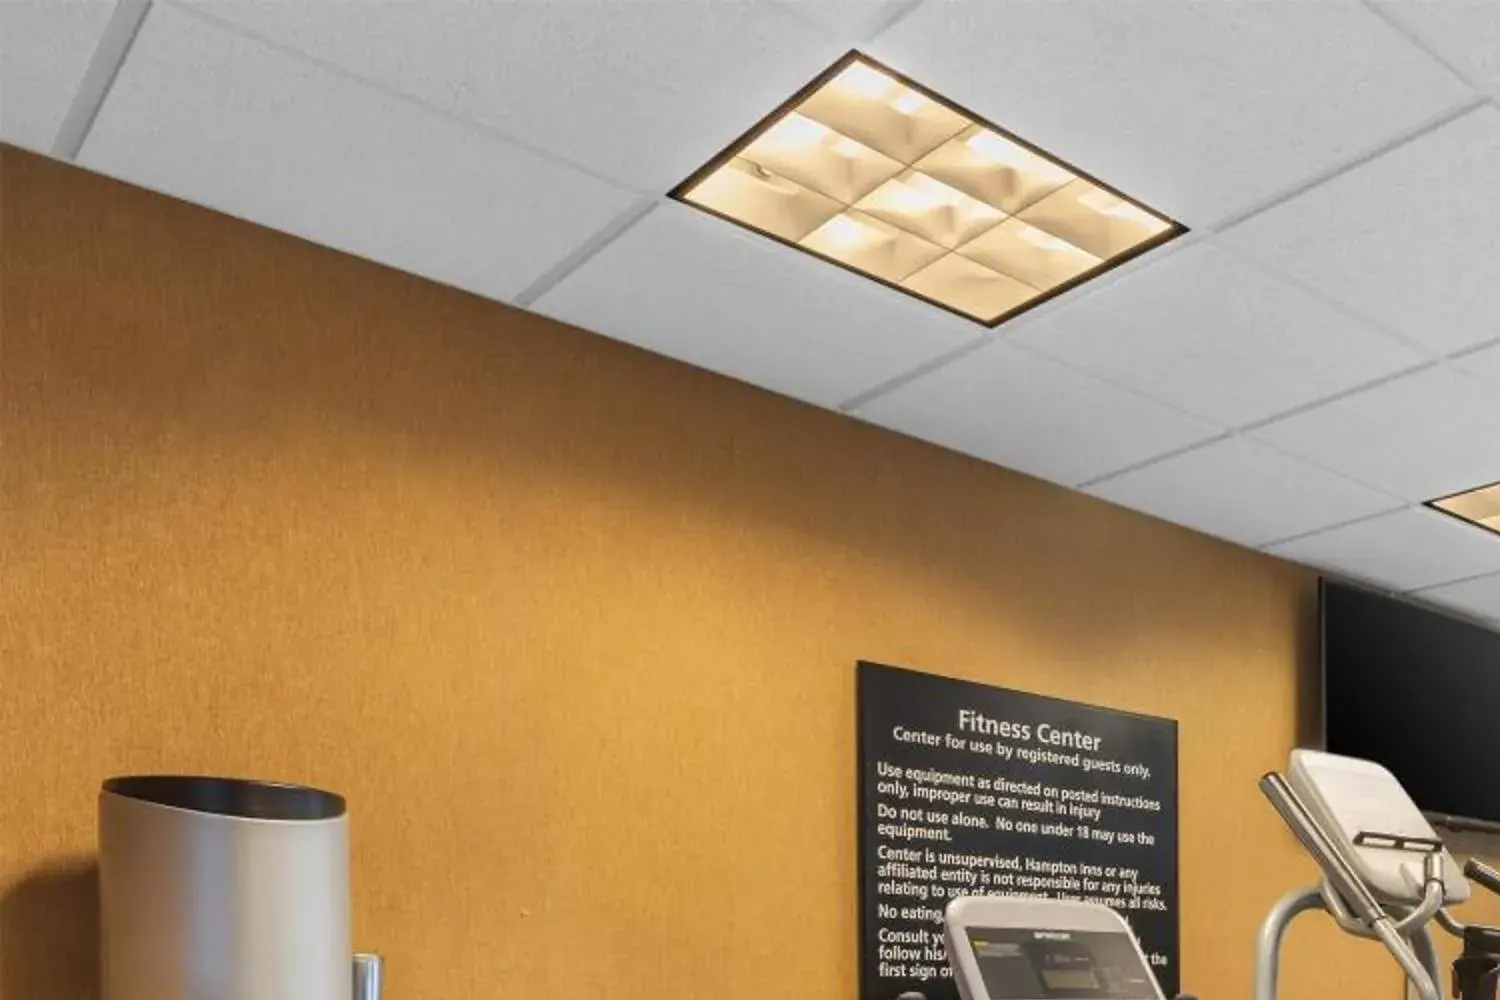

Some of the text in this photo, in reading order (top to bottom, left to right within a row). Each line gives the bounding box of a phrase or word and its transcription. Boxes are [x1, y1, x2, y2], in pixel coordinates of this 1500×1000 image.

[959, 708, 1102, 752] Fitness Center
[893, 726, 941, 747] Center
[945, 733, 966, 750] for
[969, 741, 993, 755] use
[996, 741, 1013, 760] by
[1017, 748, 1079, 767] registered
[1082, 758, 1121, 772] guests
[877, 761, 1161, 811] Use equipment as directed on posted instructions
[913, 783, 972, 805] improper
[974, 793, 995, 807] use
[997, 797, 1019, 809] can
[1021, 798, 1053, 813] result
[1055, 800, 1067, 815] in
[877, 803, 1156, 846] Do not use alone. No one under 18 may use the
[877, 822, 953, 841] equipment.
[877, 845, 922, 862] Center
[925, 847, 936, 863] is
[1025, 857, 1078, 876] Hampton
[1104, 867, 1118, 877] or
[1119, 868, 1139, 886] any
[877, 862, 938, 880] affiliated
[941, 868, 978, 886] entity
[981, 870, 992, 884] is
[993, 875, 1014, 886] not
[1017, 874, 1081, 891] responsible
[1083, 877, 1100, 891] for
[1101, 881, 1121, 896] any
[877, 880, 929, 900] relating
[931, 883, 946, 898] to
[947, 890, 969, 899] use
[1127, 896, 1141, 909] all
[877, 903, 898, 919] No
[878, 927, 929, 944] Consult
[878, 943, 921, 960] follow
[1151, 952, 1168, 967] the
[878, 961, 907, 977] first
[909, 964, 938, 981] sign
